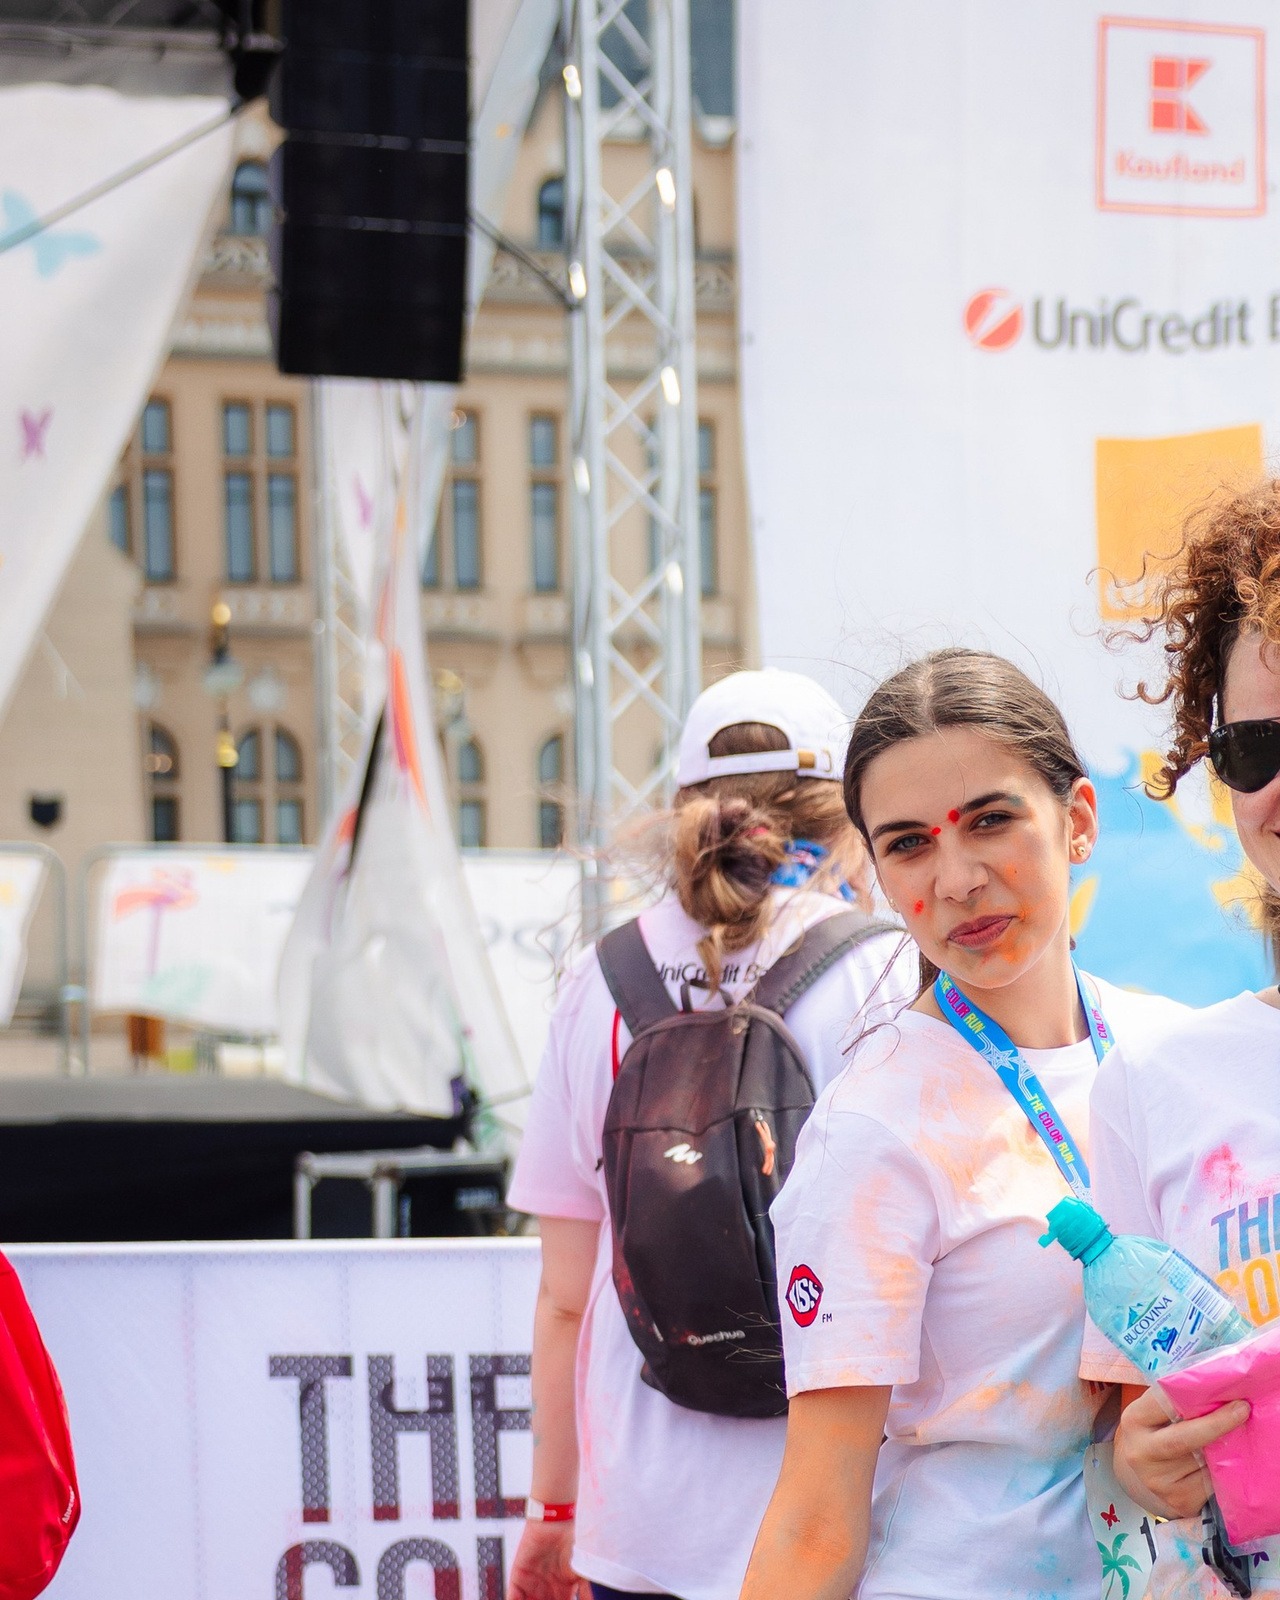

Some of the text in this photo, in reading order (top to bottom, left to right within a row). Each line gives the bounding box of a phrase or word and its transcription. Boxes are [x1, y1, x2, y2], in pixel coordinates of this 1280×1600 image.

[1116, 151, 1247, 185] Kaufland
[1031, 297, 1251, 354] UniCredit
[940, 974, 986, 1034] THE COLOR RUN
[1027, 1092, 1075, 1164] THE COLOR RUN
[686, 1330, 746, 1346] Quechua
[822, 1313, 833, 1323] FM
[1123, 1295, 1173, 1345] BUCOVINA
[269, 1354, 533, 1523] THE
